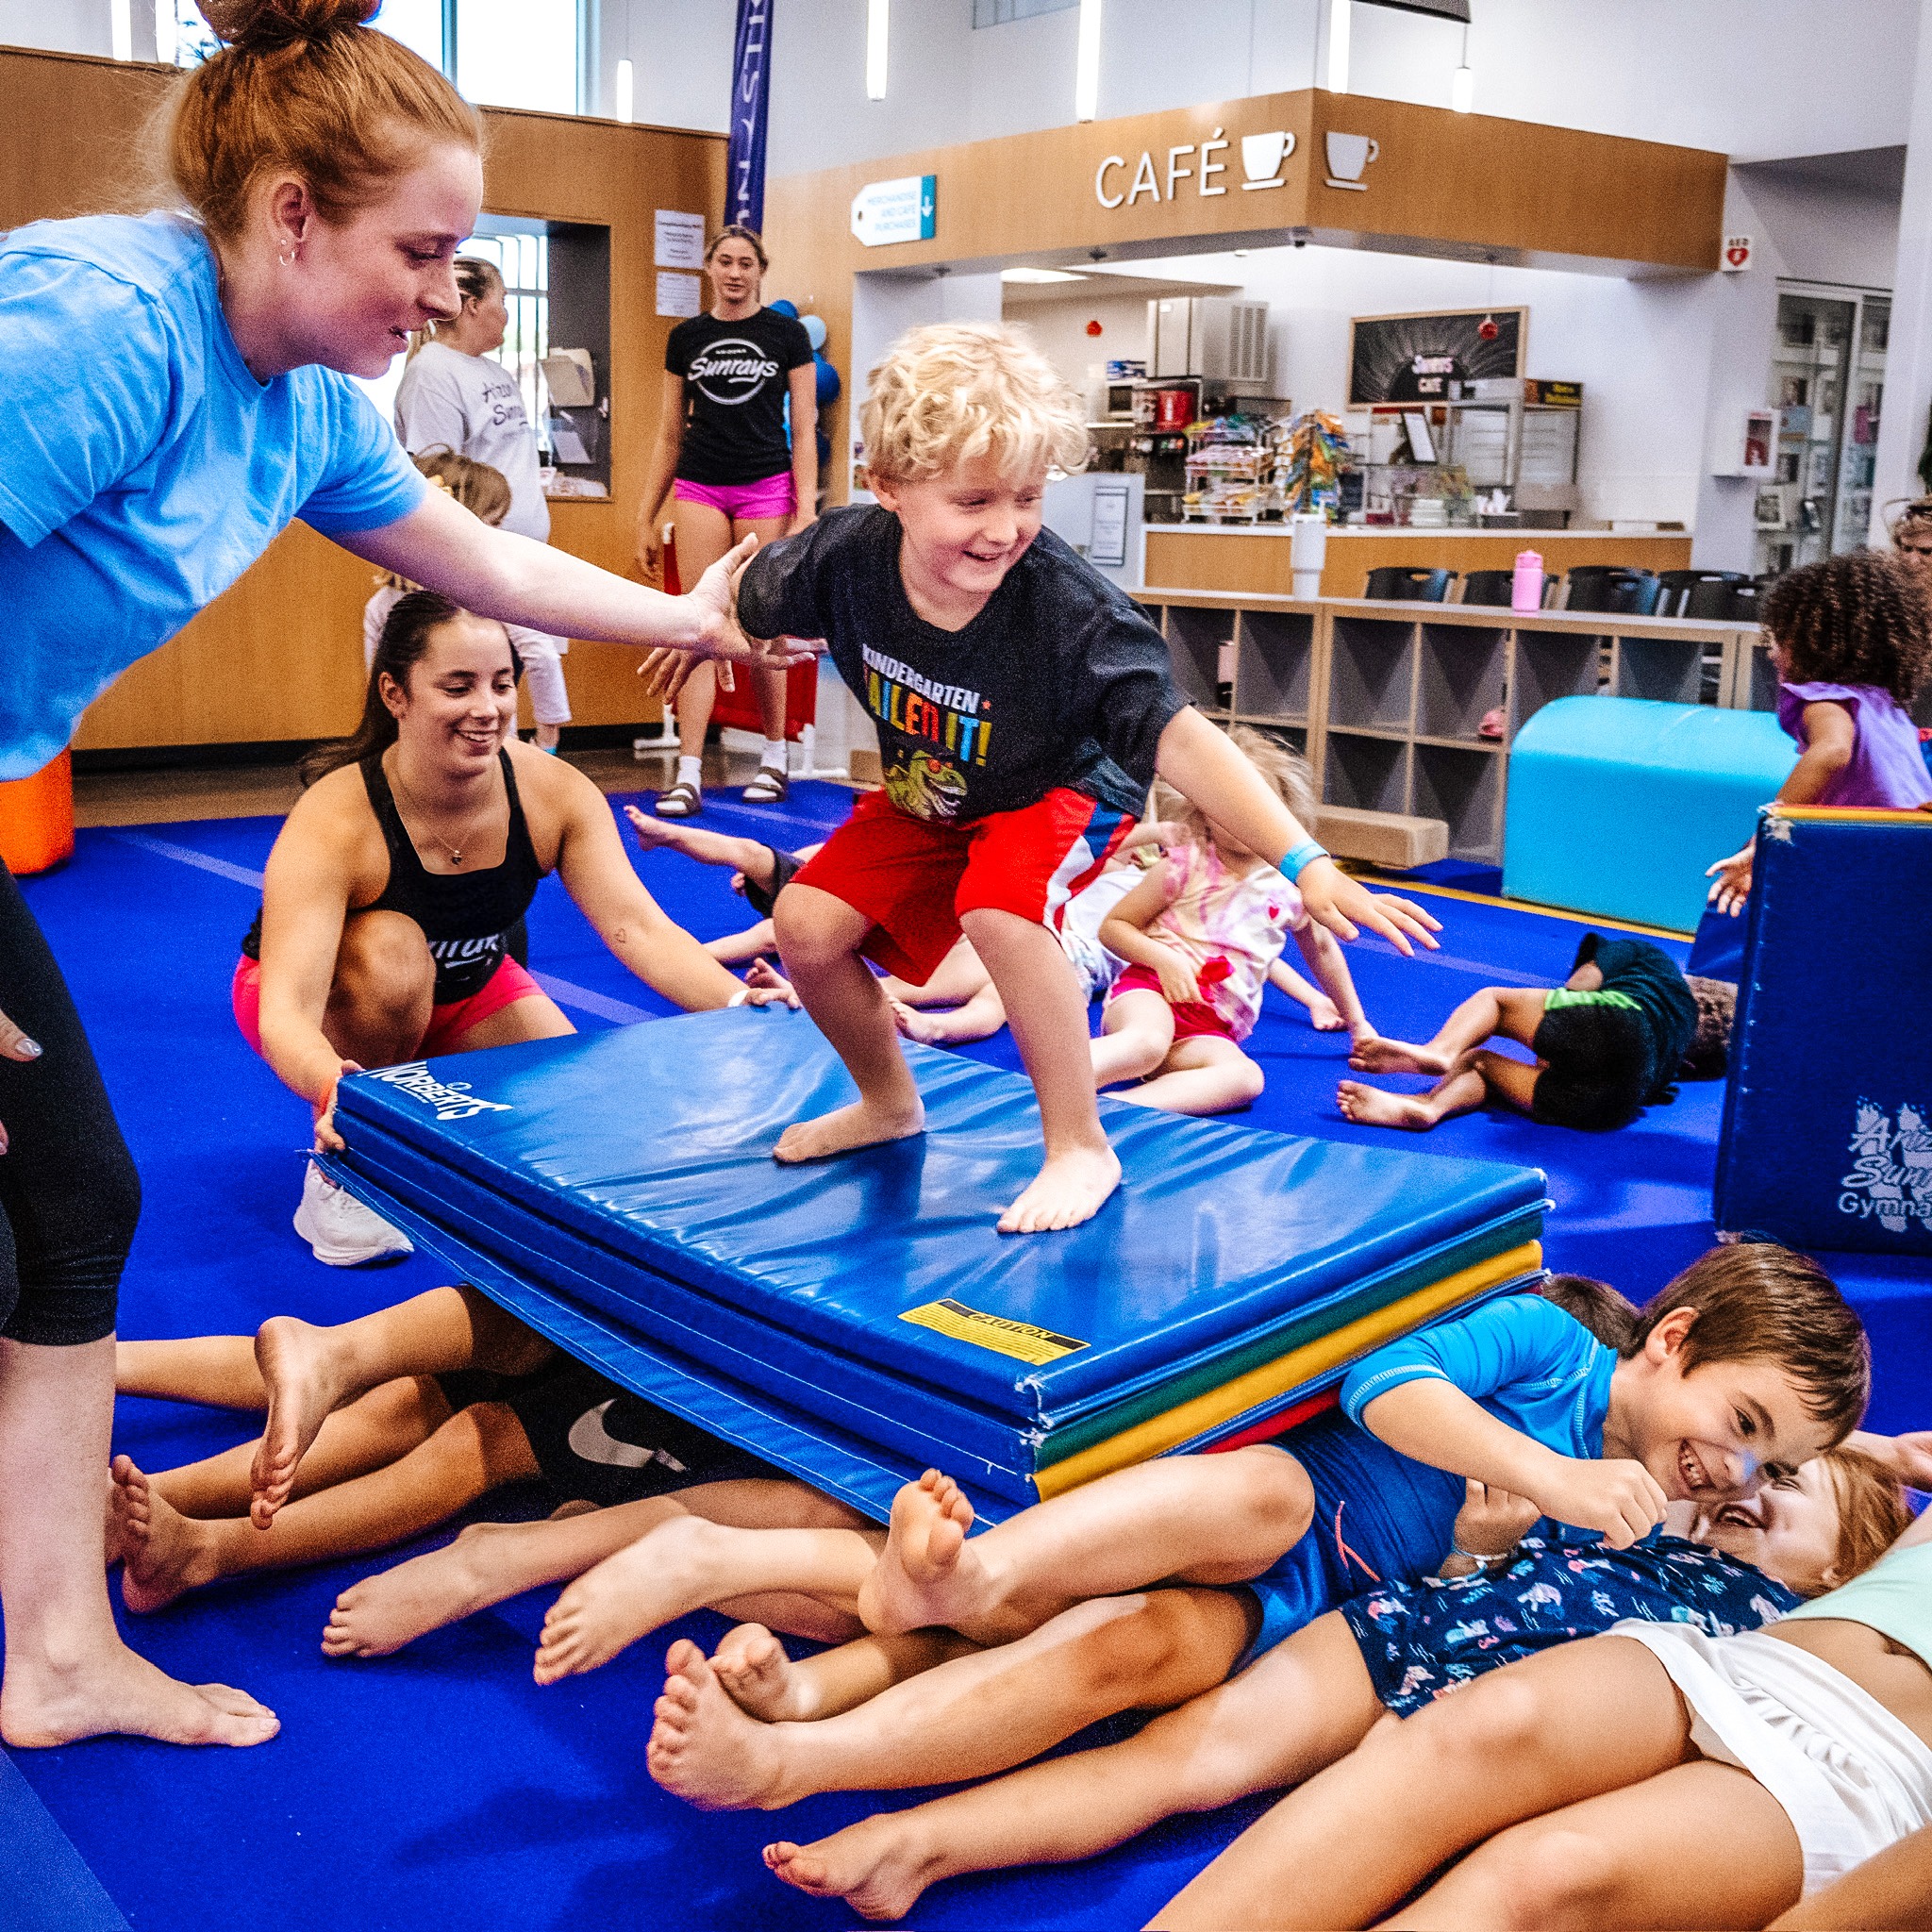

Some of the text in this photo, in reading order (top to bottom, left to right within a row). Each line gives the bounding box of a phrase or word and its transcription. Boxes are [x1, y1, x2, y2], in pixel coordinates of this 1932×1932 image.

[1095, 126, 1228, 208] CAFÉ
[688, 357, 779, 383] Sunrays
[945, 712, 992, 767] IT!
[968, 1312, 1054, 1340] CAUTION
